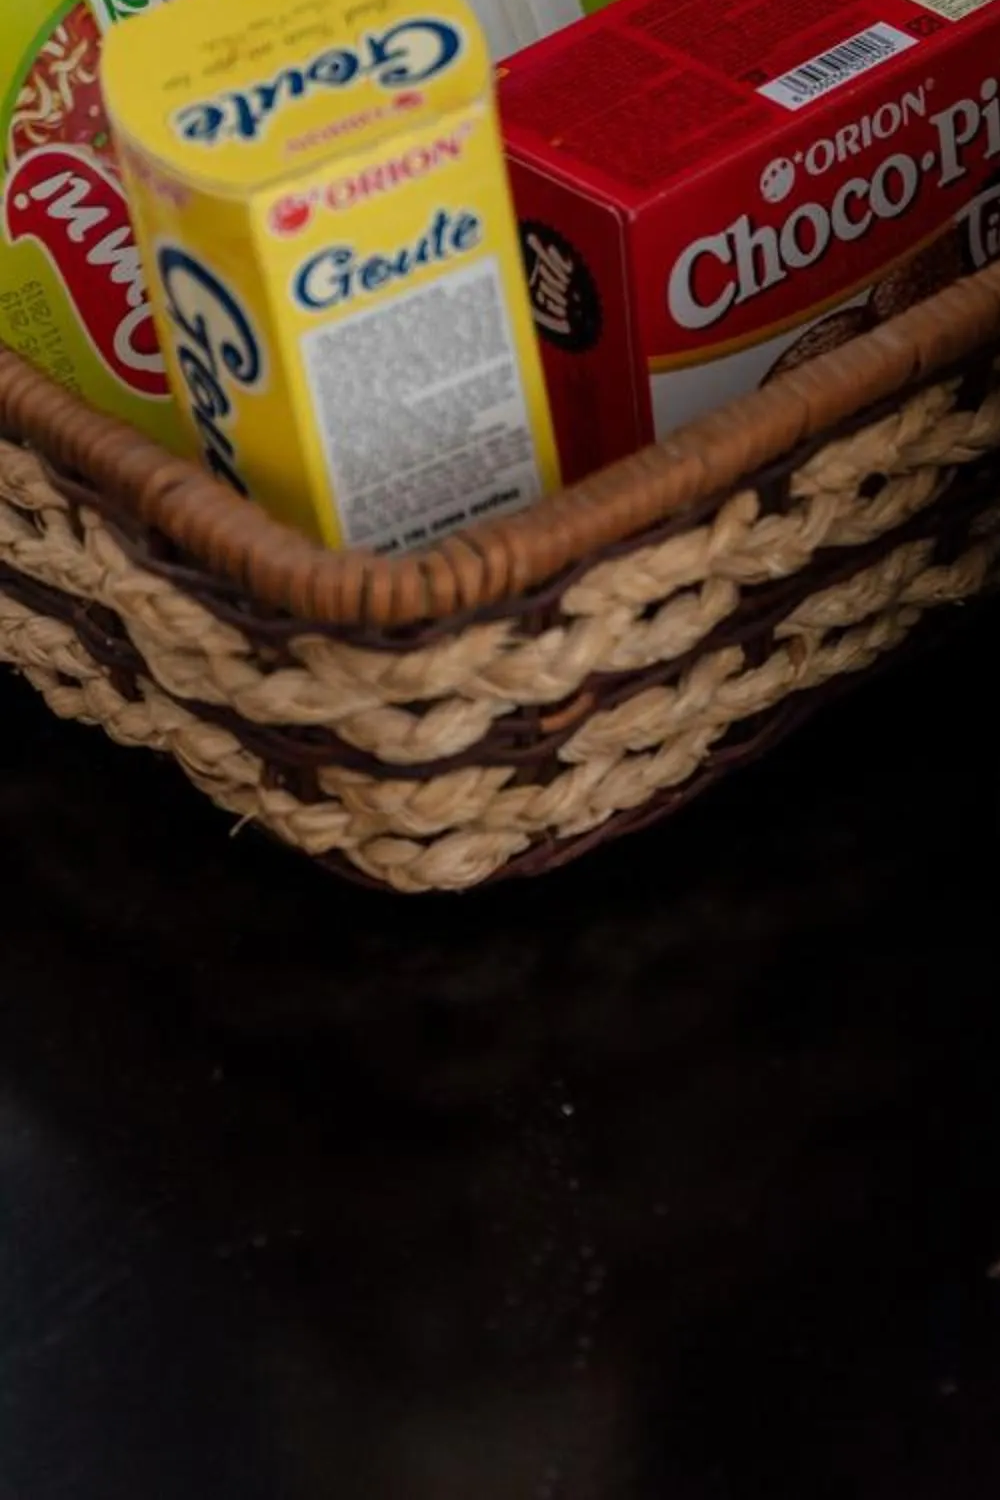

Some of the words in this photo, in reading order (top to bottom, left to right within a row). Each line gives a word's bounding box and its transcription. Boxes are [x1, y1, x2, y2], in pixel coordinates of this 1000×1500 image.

[320, 133, 463, 211] ORION
[803, 86, 926, 177] ORION
[156, 245, 261, 499] Gou
